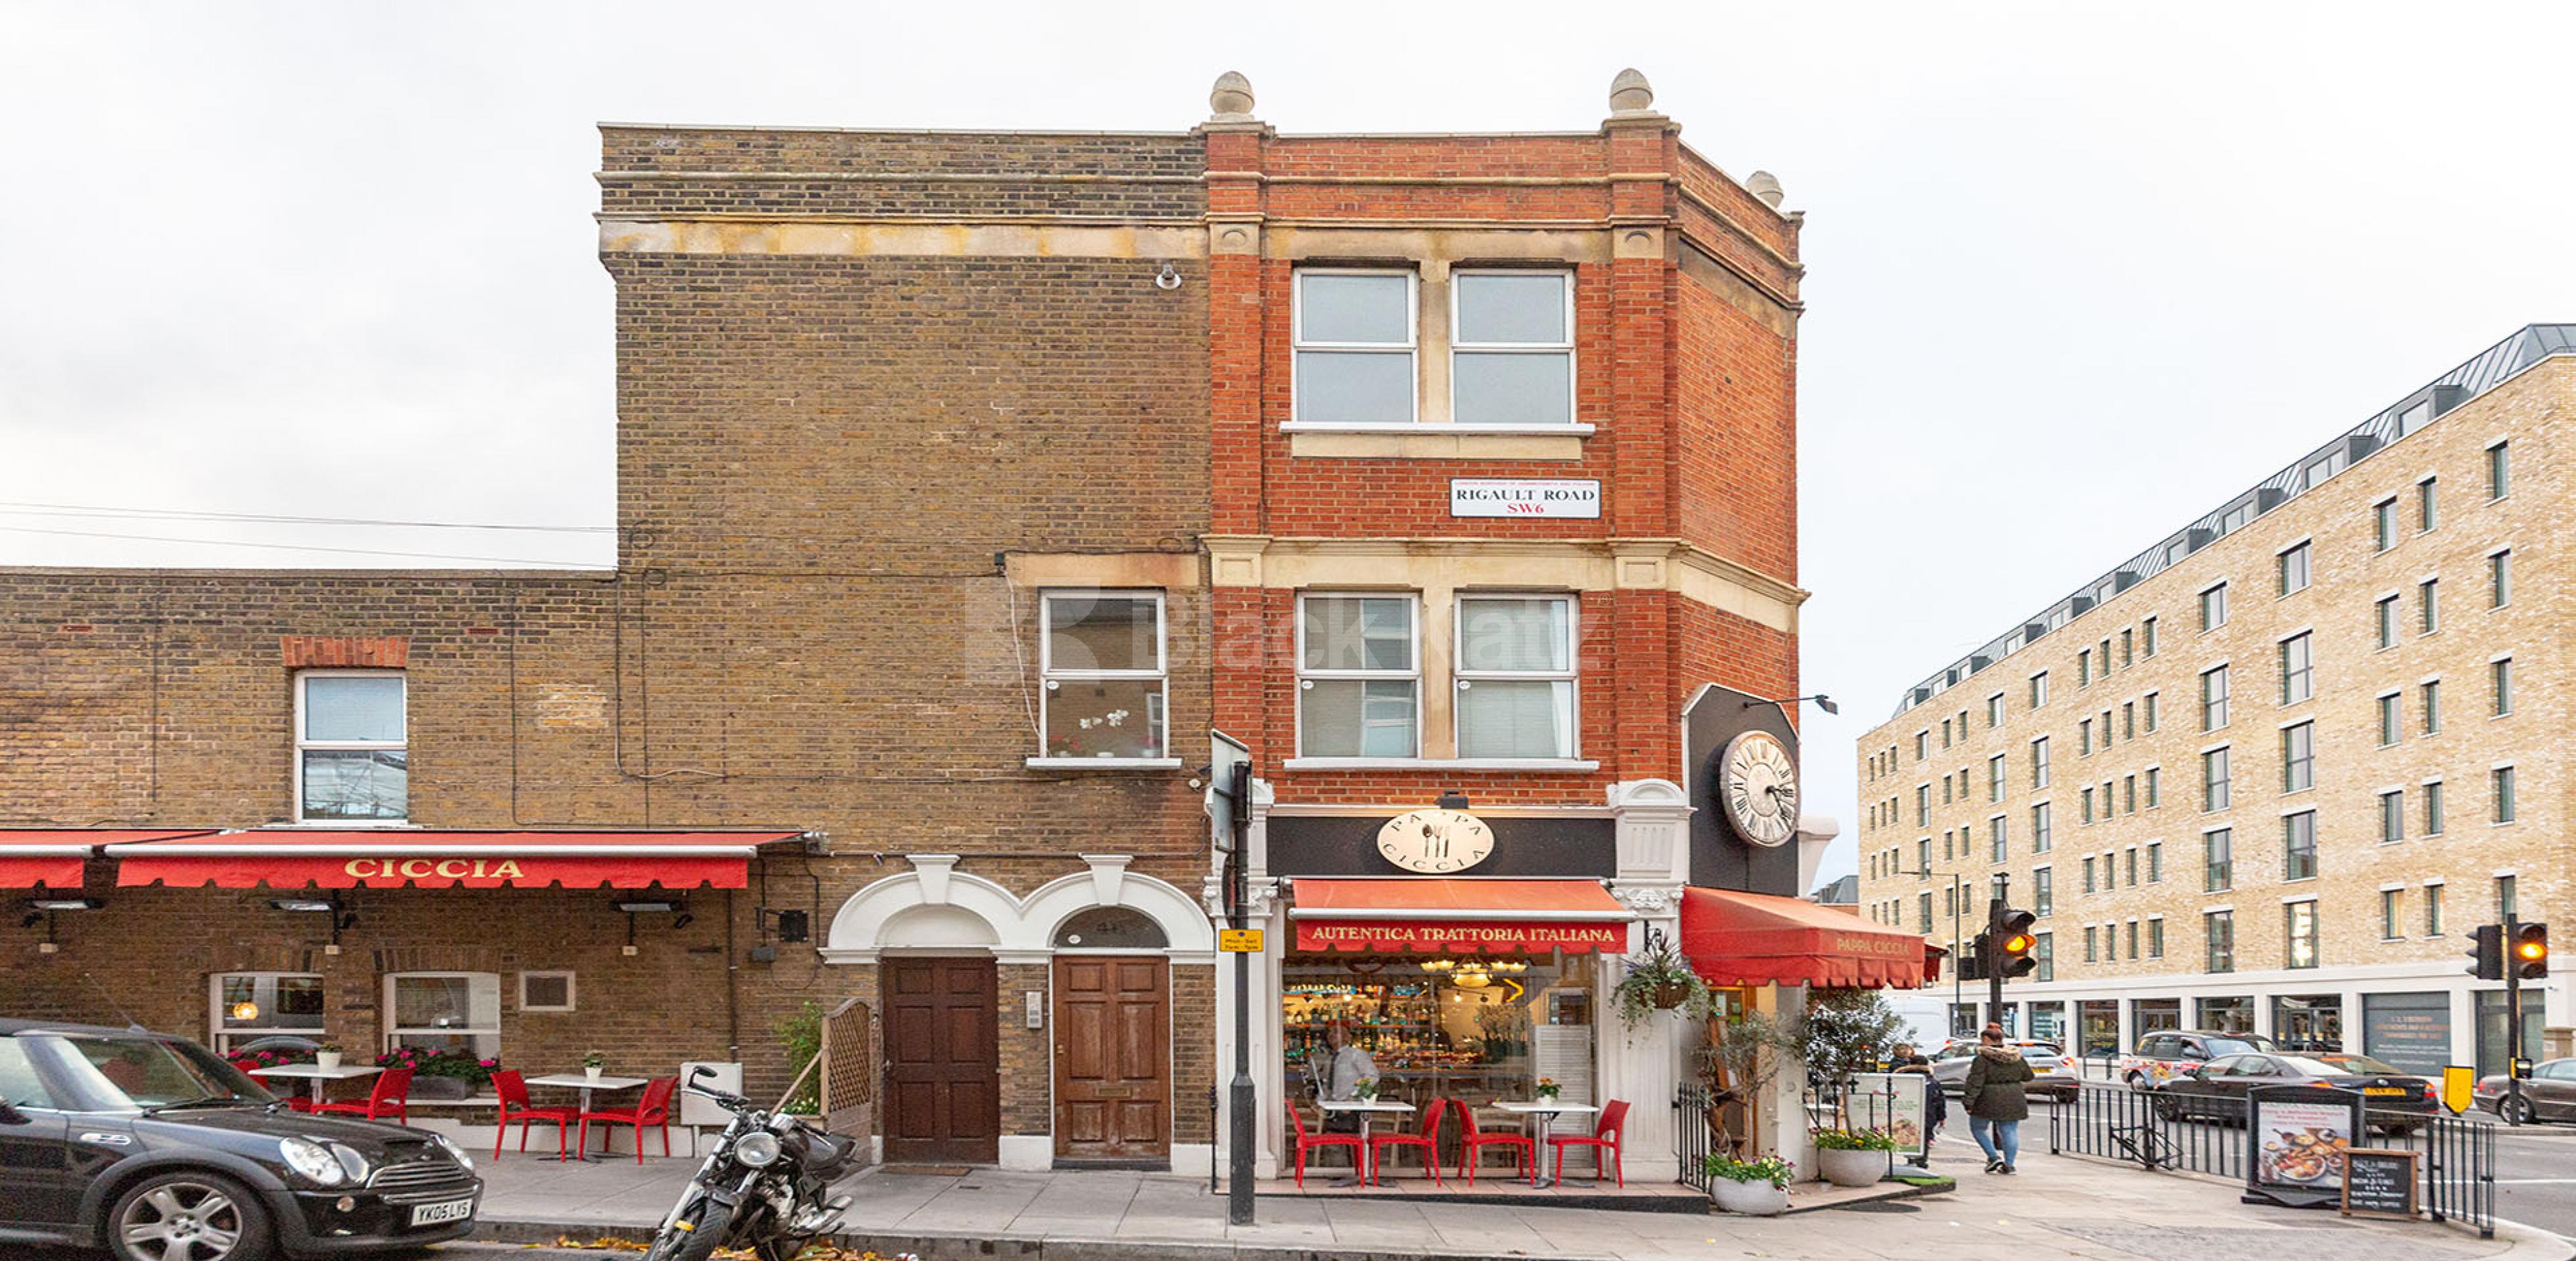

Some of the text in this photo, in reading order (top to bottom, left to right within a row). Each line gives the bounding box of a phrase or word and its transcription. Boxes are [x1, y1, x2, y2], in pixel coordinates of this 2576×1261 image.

[1457, 489, 1594, 500] RIGAULT ROAD
[1507, 503, 1544, 514] SW6
[1382, 843, 1485, 871] CICCIA
[344, 859, 525, 878] CICCIA
[1312, 926, 1615, 942] AUTENTICA TRATTORIA ITALIANA
